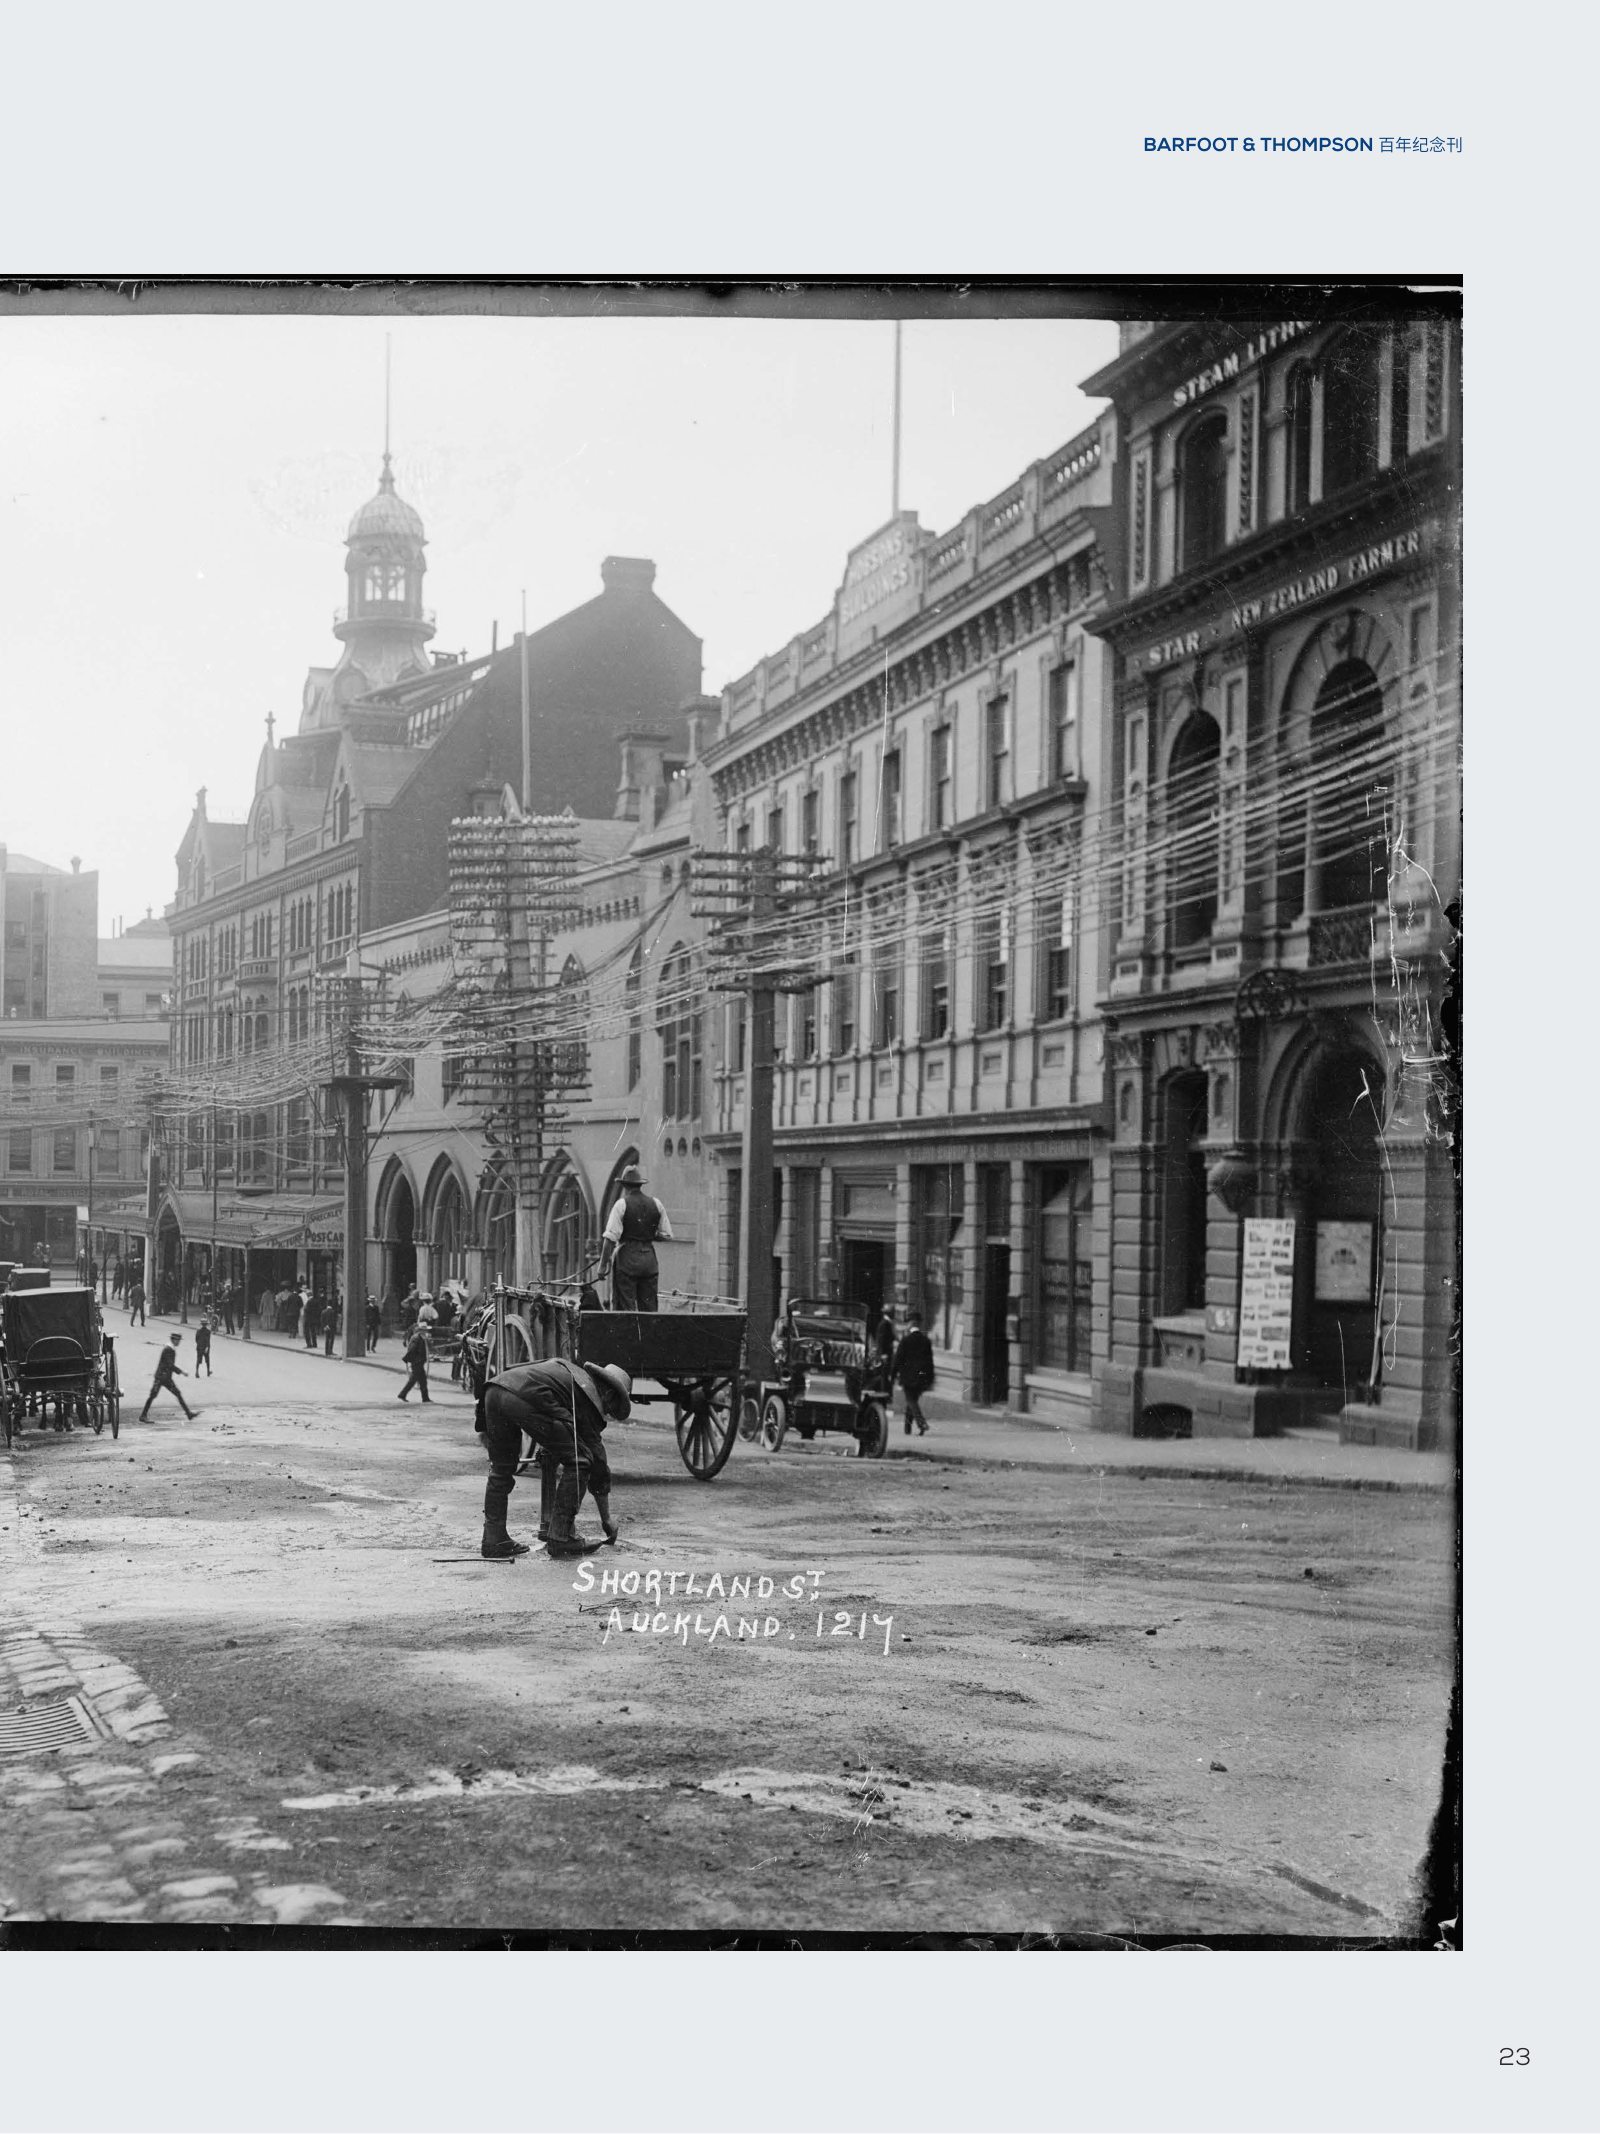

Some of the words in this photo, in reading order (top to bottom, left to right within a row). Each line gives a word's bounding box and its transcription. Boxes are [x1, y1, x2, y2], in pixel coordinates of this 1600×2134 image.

[1173, 352, 1239, 407] STEAM
[1147, 631, 1201, 666] STAR
[1231, 599, 1264, 630] NEW
[1268, 565, 1339, 615] ZEALAND
[1347, 530, 1421, 580] FARMER
